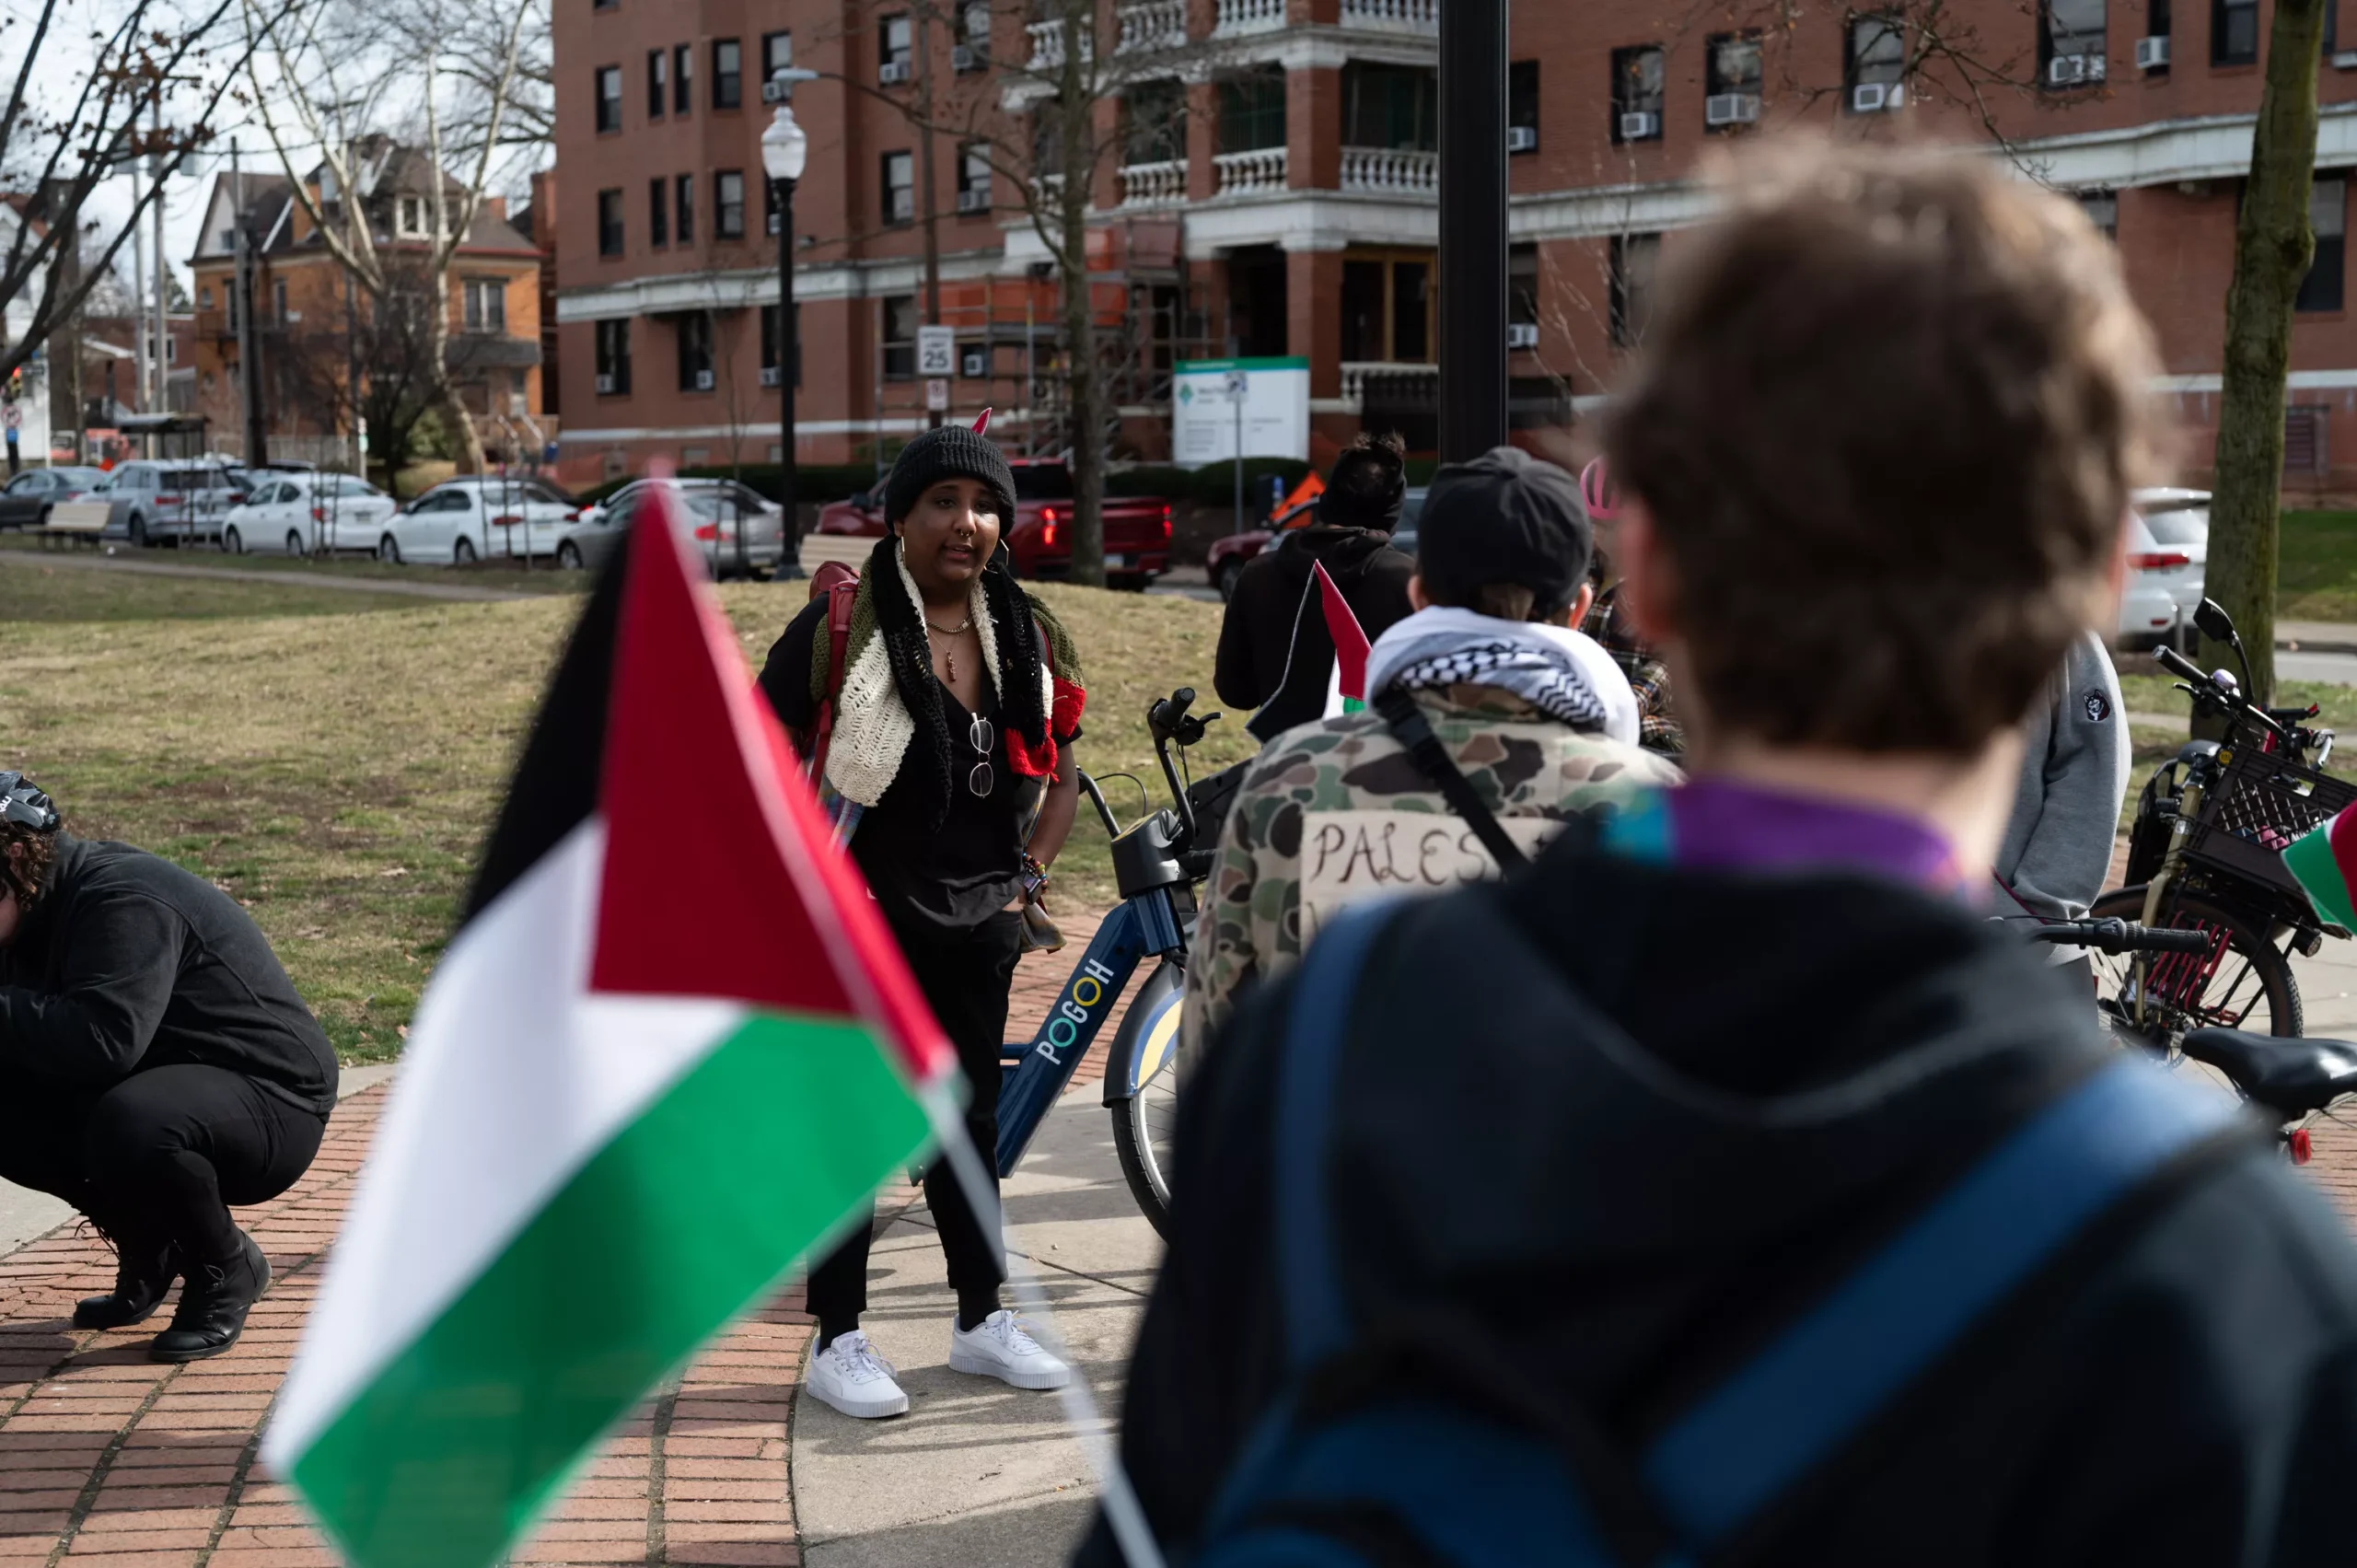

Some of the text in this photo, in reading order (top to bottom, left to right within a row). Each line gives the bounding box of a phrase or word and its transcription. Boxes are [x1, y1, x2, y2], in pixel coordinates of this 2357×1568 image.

[924, 349, 948, 368] 25
[1309, 821, 1488, 886] PALES
[1036, 958, 1114, 1065] POGOH
